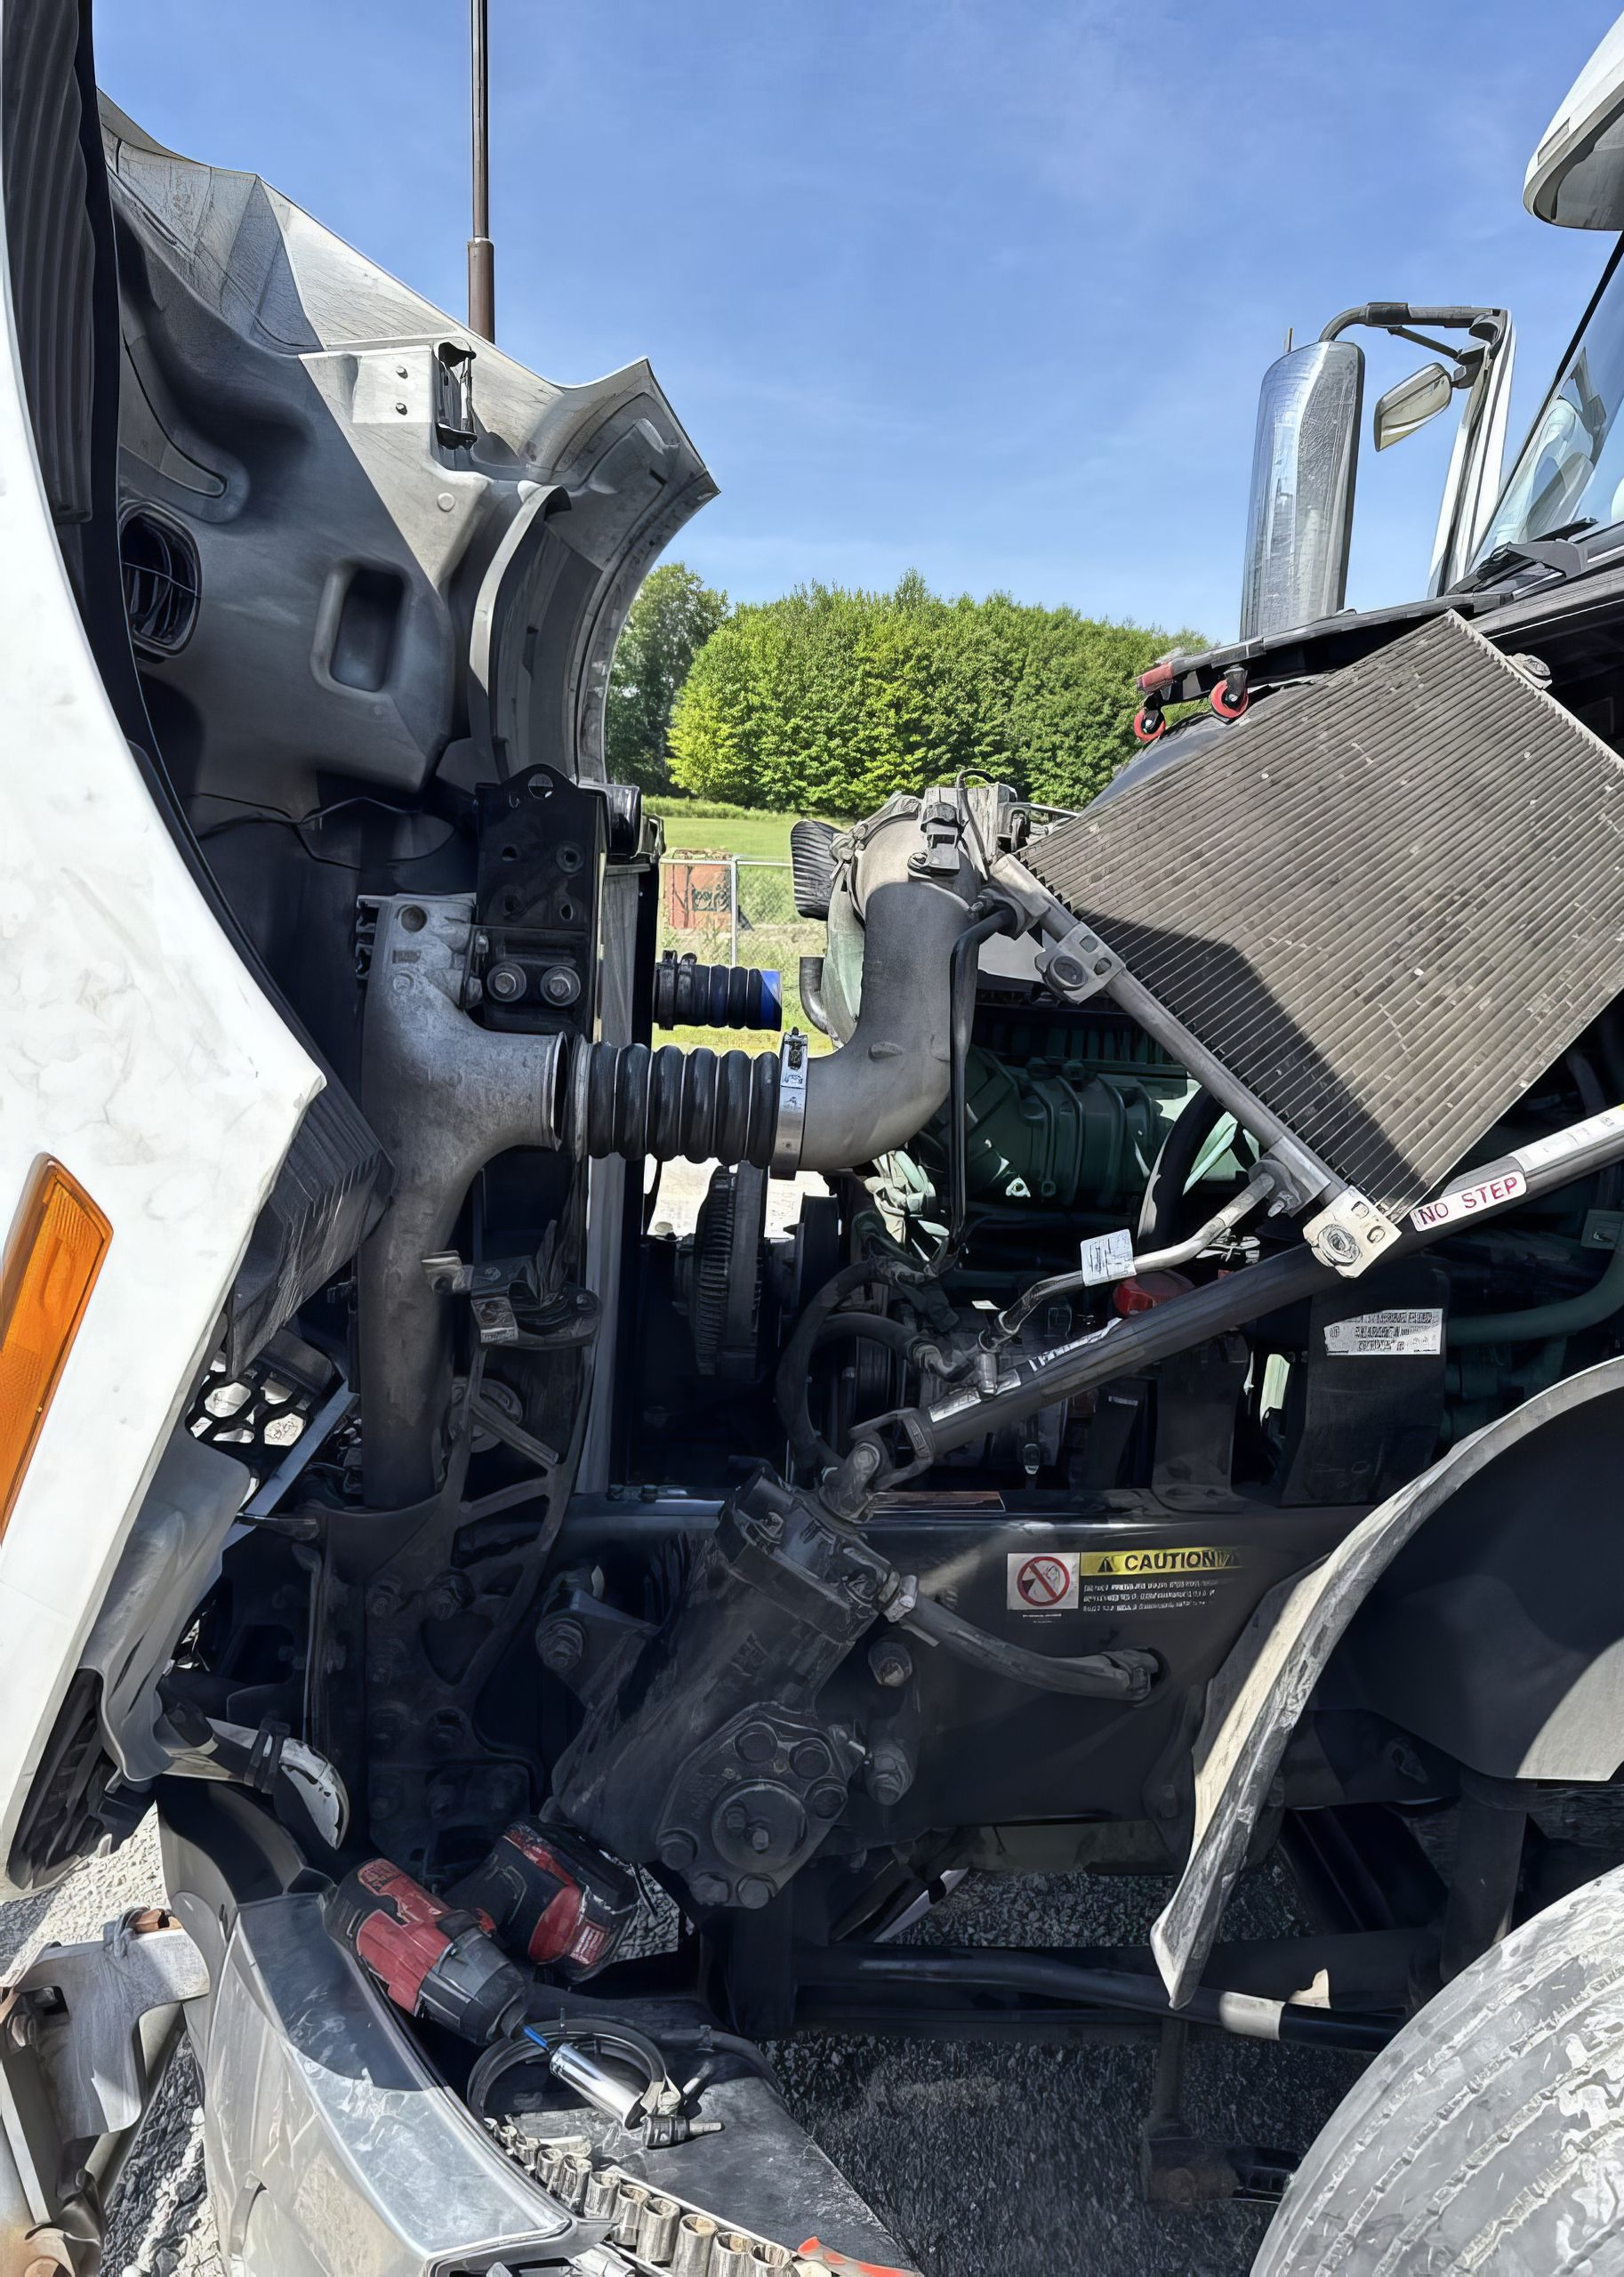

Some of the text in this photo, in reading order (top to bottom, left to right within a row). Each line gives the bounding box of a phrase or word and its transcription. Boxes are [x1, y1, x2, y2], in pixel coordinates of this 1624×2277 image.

[1419, 1177, 1517, 1225] NO STEP
[1124, 1549, 1217, 1571] CAUTION
